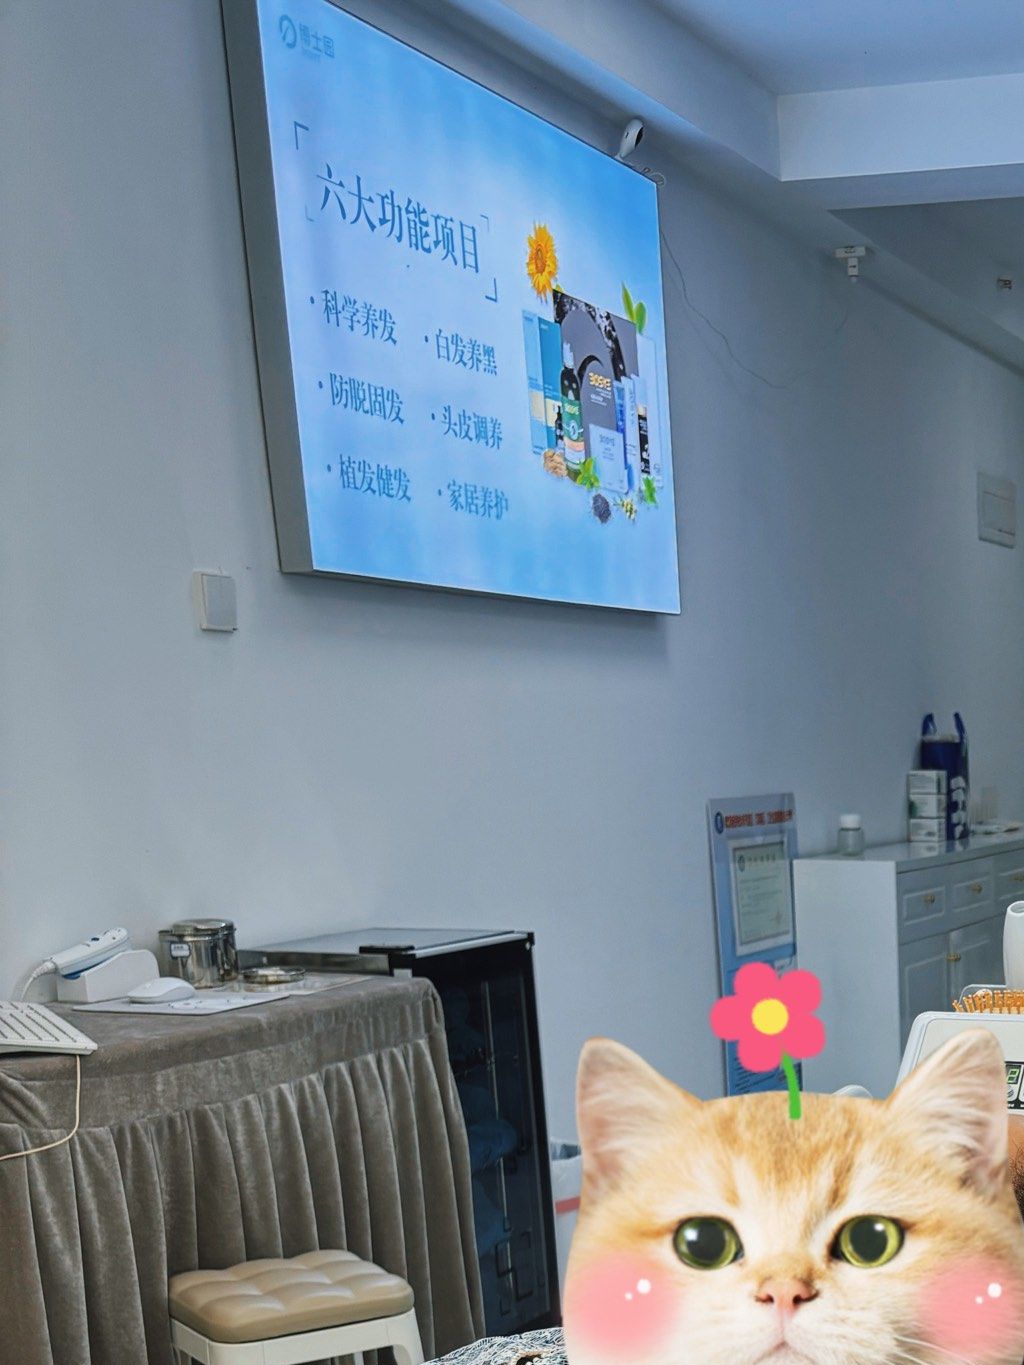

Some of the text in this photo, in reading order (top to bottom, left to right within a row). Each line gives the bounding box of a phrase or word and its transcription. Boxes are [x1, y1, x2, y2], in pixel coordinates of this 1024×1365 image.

[316, 163, 479, 274] 六大功能项目
[321, 289, 397, 346] 科学养发
[435, 328, 498, 376] 白发养黑
[329, 372, 404, 424] 防脱固发
[440, 405, 503, 450] 头皮调养
[339, 453, 412, 502] 植发健发
